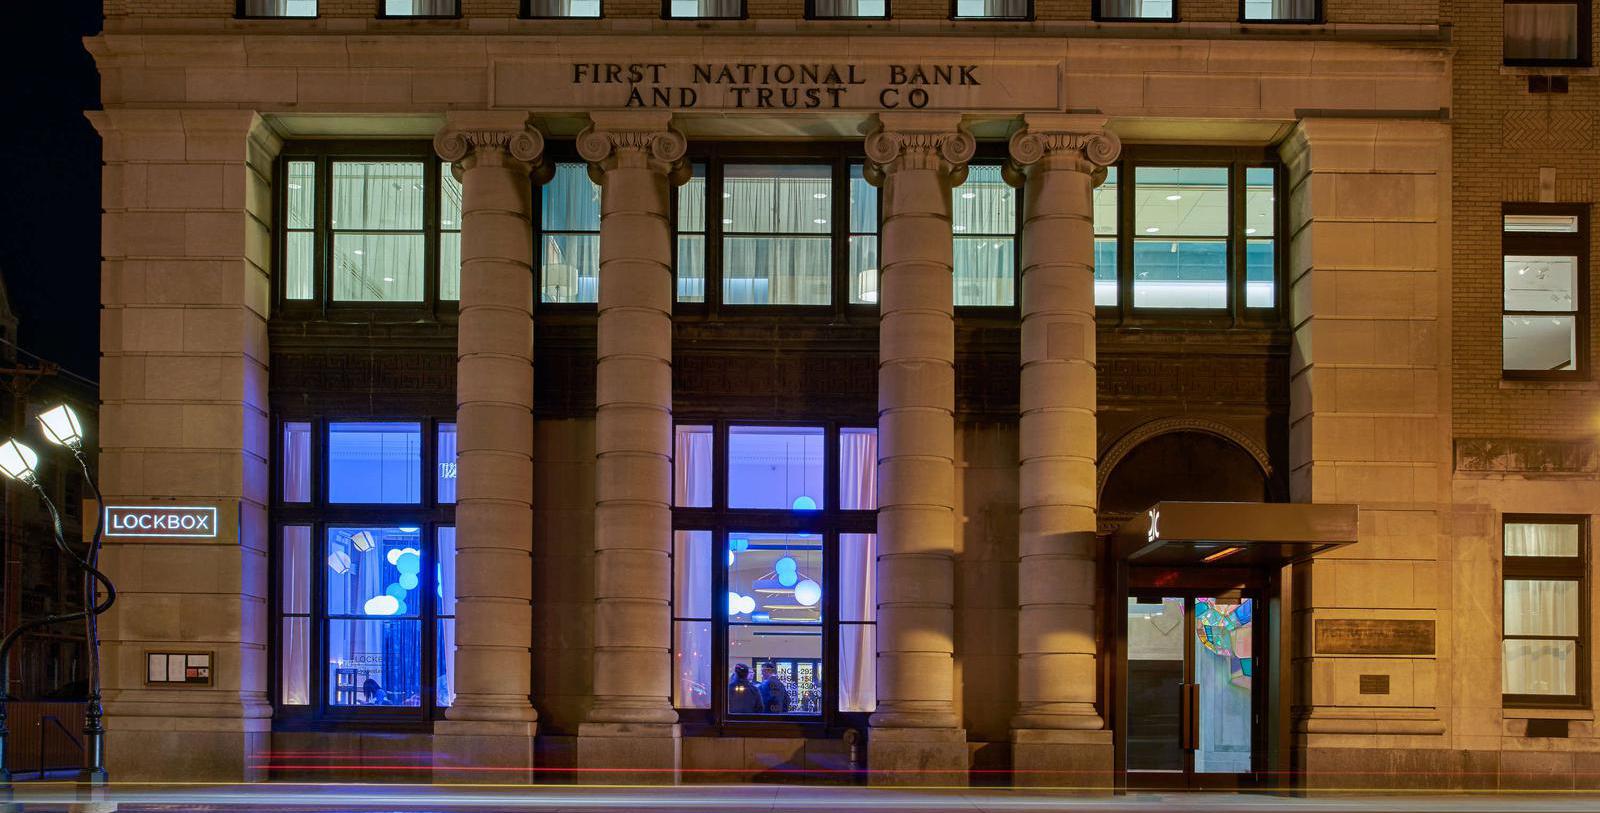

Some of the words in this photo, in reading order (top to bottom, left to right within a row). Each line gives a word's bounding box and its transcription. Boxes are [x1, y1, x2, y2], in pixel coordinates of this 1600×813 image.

[572, 63, 667, 85] FIRST
[693, 63, 866, 86] NATIONAL
[889, 64, 982, 86] BANK
[625, 86, 698, 108] AND
[730, 87, 847, 109] TRUST
[879, 87, 930, 109] CO
[113, 514, 209, 530] LOCKBOX
